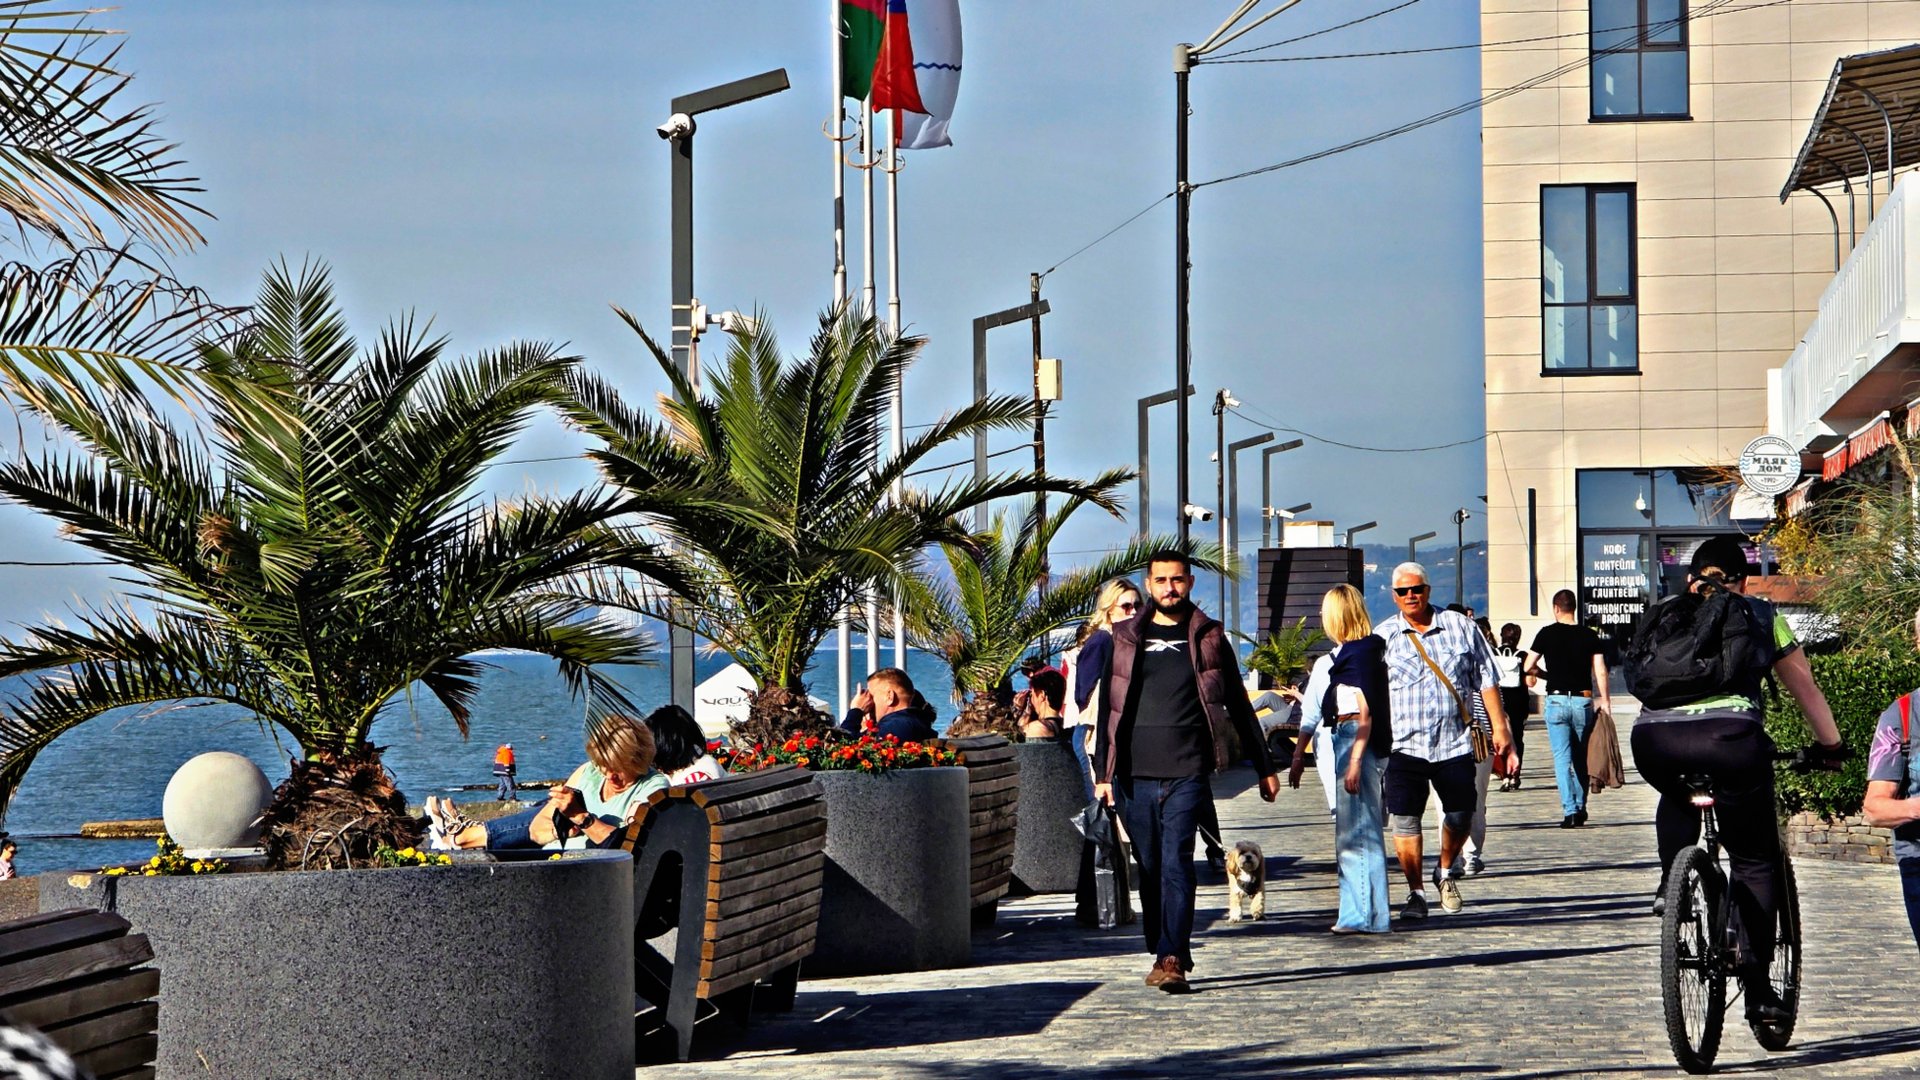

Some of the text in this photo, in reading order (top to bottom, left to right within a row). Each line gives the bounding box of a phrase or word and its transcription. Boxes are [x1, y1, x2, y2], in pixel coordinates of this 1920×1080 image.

[1752, 457, 1787, 465] МАЯК
[1757, 465, 1782, 473] ДОМ
[1603, 544, 1627, 555] КОФЕ
[1594, 558, 1636, 570] КОКТЕЙЛИ
[1584, 574, 1646, 587] СОГРЕВАЮЩИЙ
[1592, 587, 1639, 598] ГЛИНТВЕЙН
[1588, 603, 1644, 614] ГОНКОНГСКИЕ
[1601, 614, 1631, 624] ВАФЛИ
